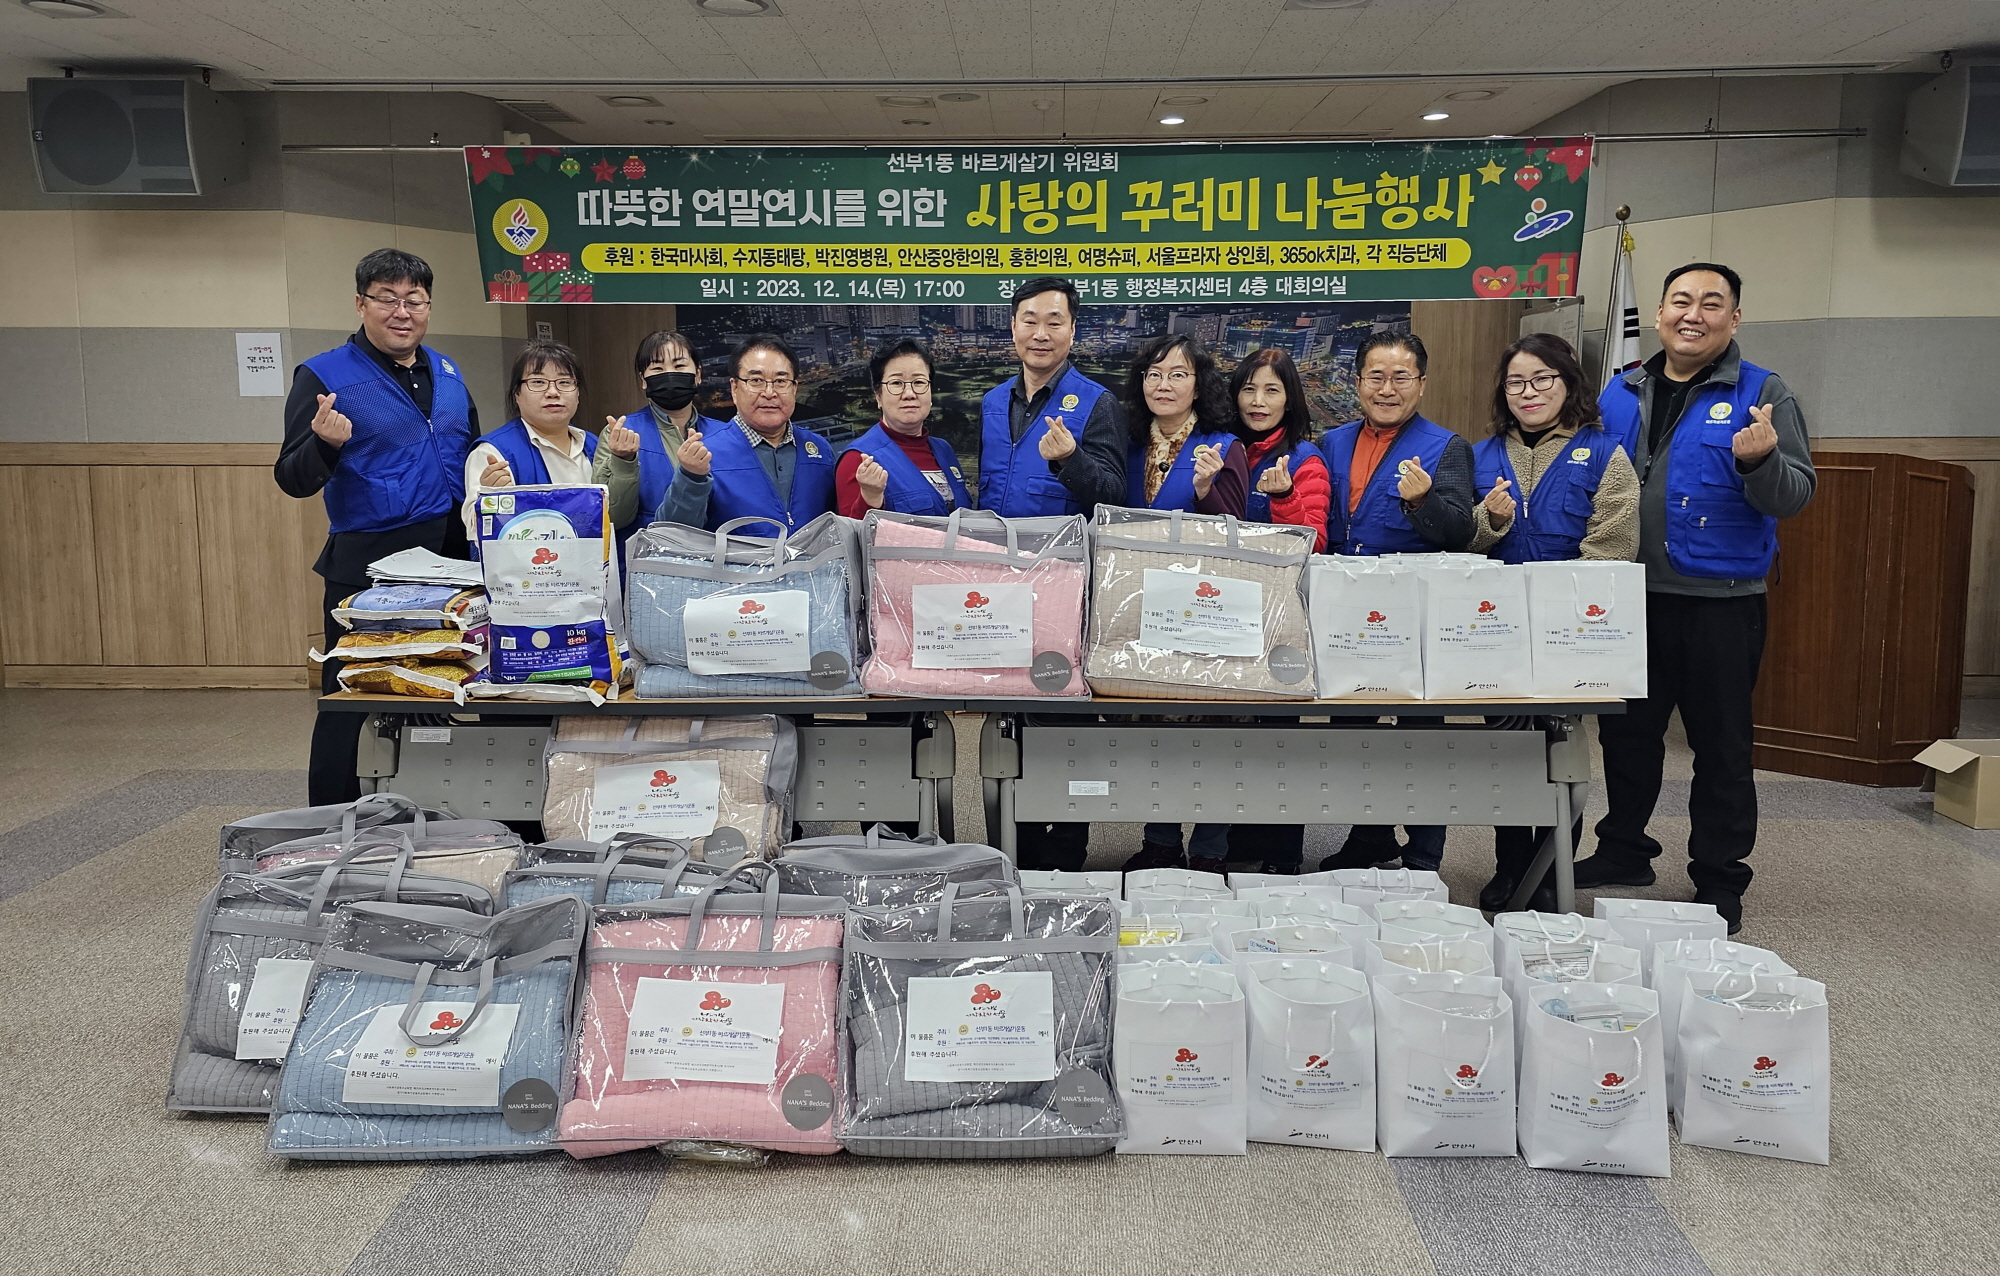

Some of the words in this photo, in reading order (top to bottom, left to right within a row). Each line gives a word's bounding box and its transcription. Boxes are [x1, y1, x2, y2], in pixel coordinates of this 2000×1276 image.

[886, 152, 955, 173] 선부1동
[961, 152, 1056, 173] 바르게살기
[1062, 152, 1119, 172] 위원회
[577, 188, 682, 228] 따뜻한
[692, 188, 867, 228] 연말연시를
[877, 187, 947, 227] 위한
[966, 178, 1108, 236] 사랑의
[1121, 177, 1259, 233] 꾸러미
[1275, 171, 1475, 230] 나눔행사
[604, 247, 634, 266] 후원
[650, 247, 727, 267] 한국마사회,
[732, 247, 810, 268] 수지동태탕,
[815, 247, 892, 268] 박진영병원,
[897, 247, 1002, 268] 안산중앙한의원,
[1008, 247, 1073, 267] 홍한의원,
[1078, 247, 1141, 267] 여명슈퍼,
[1146, 247, 1220, 265] 서울프라자
[1225, 246, 1274, 265] 상인회,
[1279, 246, 1361, 265] 365ok치과,
[1366, 246, 1381, 264] 각
[1386, 245, 1447, 264] 직능단체
[700, 279, 735, 297] 일시
[756, 280, 805, 297] 2023.
[813, 280, 840, 297] 12.
[848, 280, 906, 298] 14.(목)
[914, 280, 965, 296] 17:00
[1068, 279, 1119, 298] 부1동
[1126, 278, 1232, 298] 행정복지센터
[1239, 278, 1268, 296] 4층
[1275, 276, 1347, 296] 대회의실
[567, 629, 575, 637] 10
[576, 629, 586, 637] kg
[809, 1100, 830, 1108] Bedding
